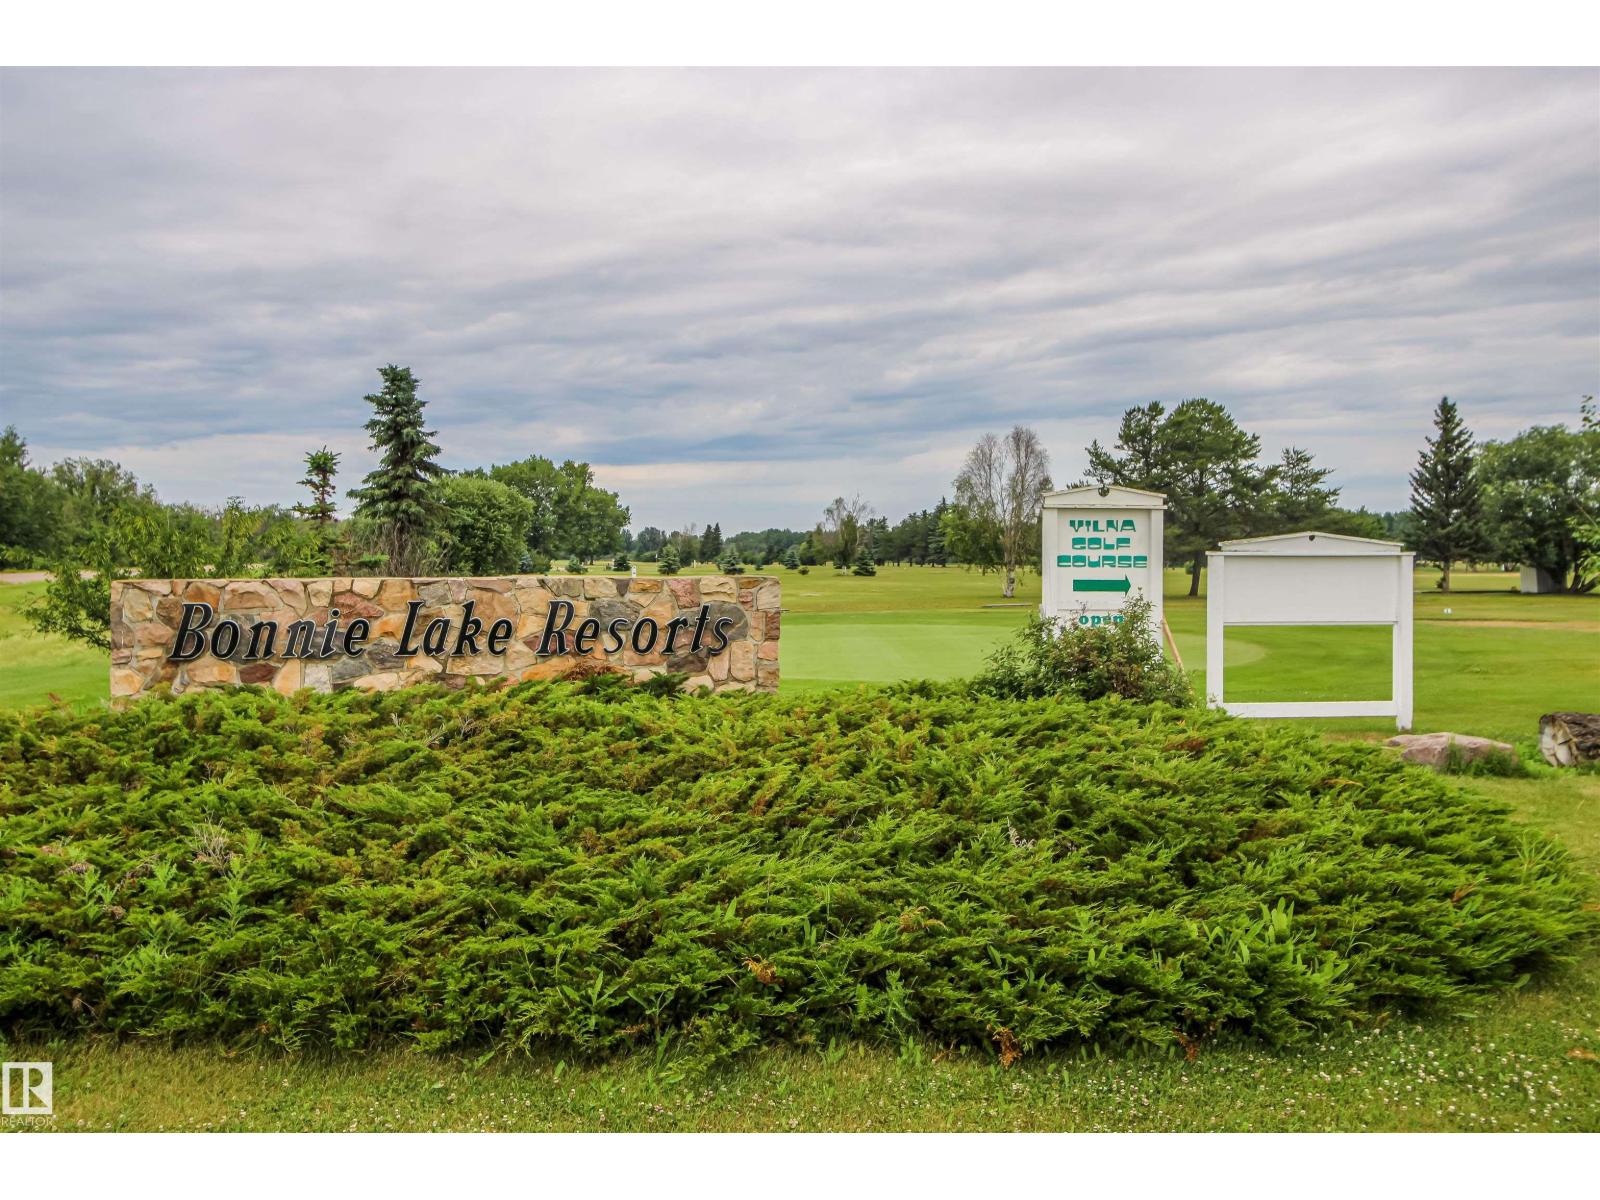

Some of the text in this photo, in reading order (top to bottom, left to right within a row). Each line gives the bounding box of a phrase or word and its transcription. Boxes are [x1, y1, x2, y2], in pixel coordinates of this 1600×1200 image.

[1069, 520, 1136, 532] VILNA
[1072, 537, 1131, 550] GOLF
[1057, 555, 1147, 568] COURSE
[169, 599, 734, 661] Bonnie Lake Resorts
